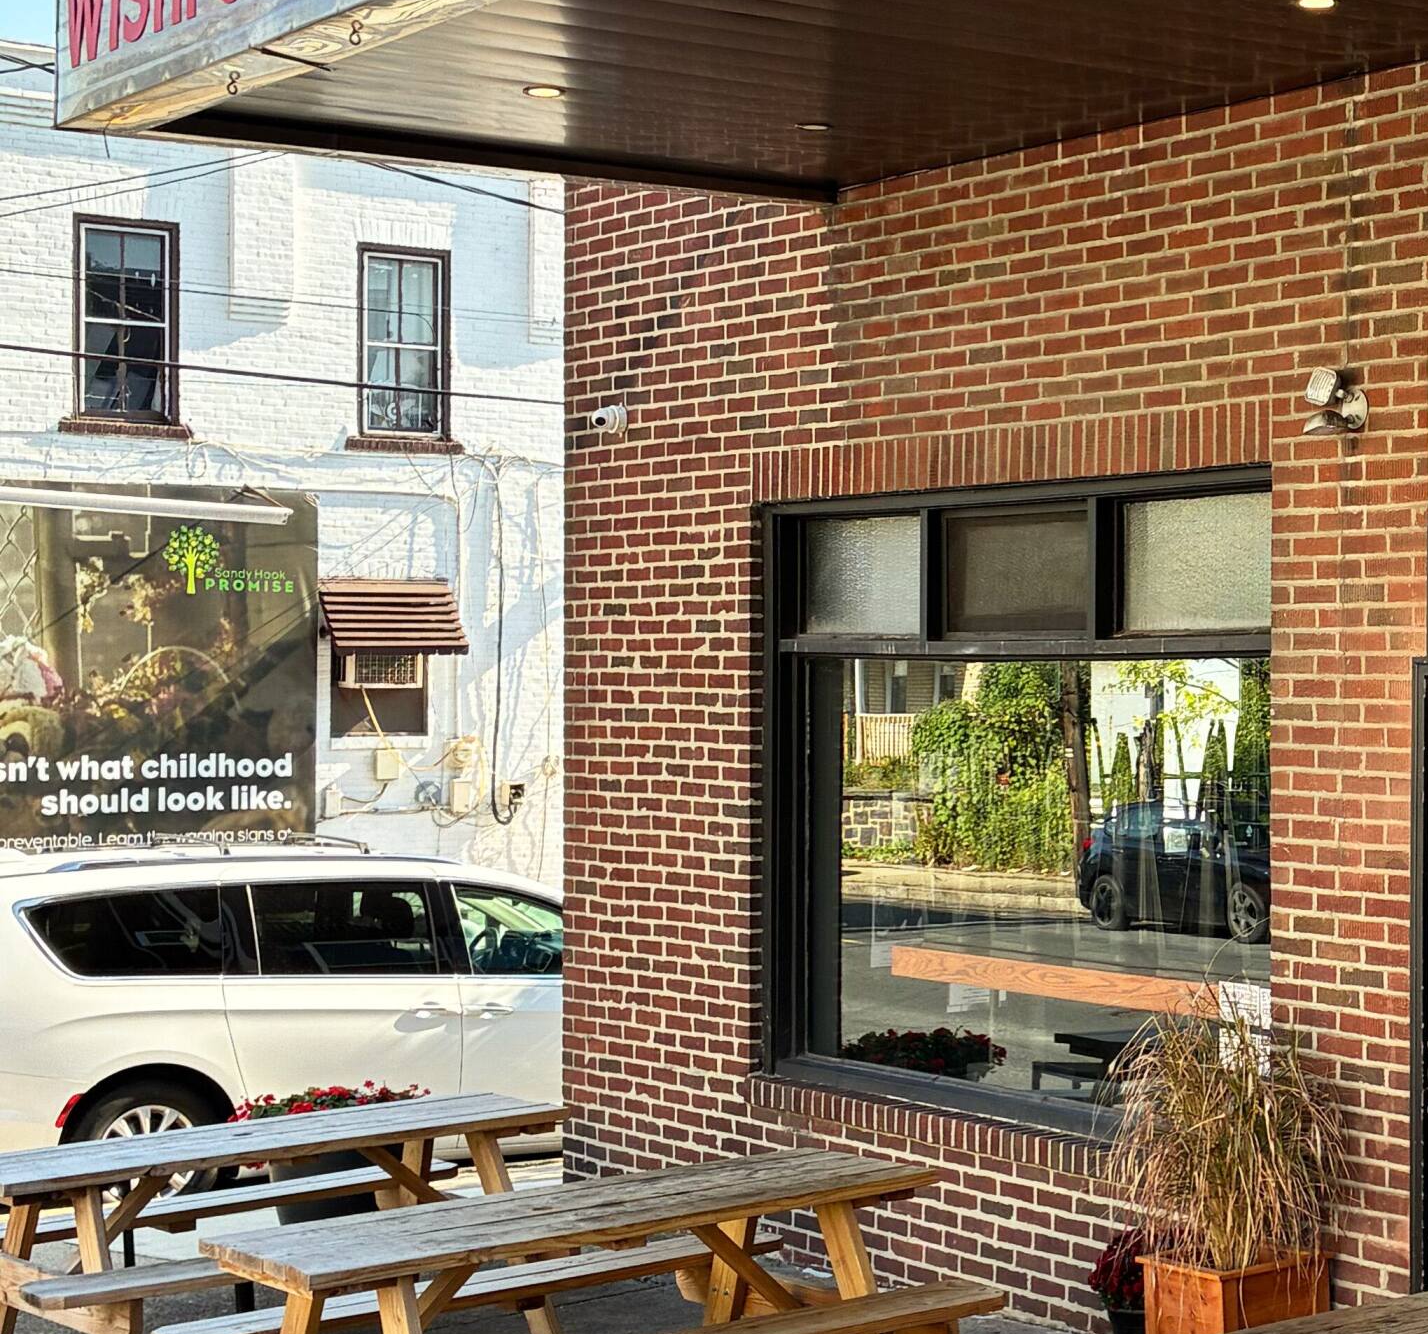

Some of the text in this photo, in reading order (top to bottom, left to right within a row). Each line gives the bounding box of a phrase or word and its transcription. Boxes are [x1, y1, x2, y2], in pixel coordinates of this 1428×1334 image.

[214, 567, 286, 581] Sandy Hook
[205, 578, 294, 593] PROMISE
[56, 755, 134, 781] what
[141, 752, 293, 779] childhood
[41, 785, 292, 816] should look like.
[238, 829, 275, 843] signs
